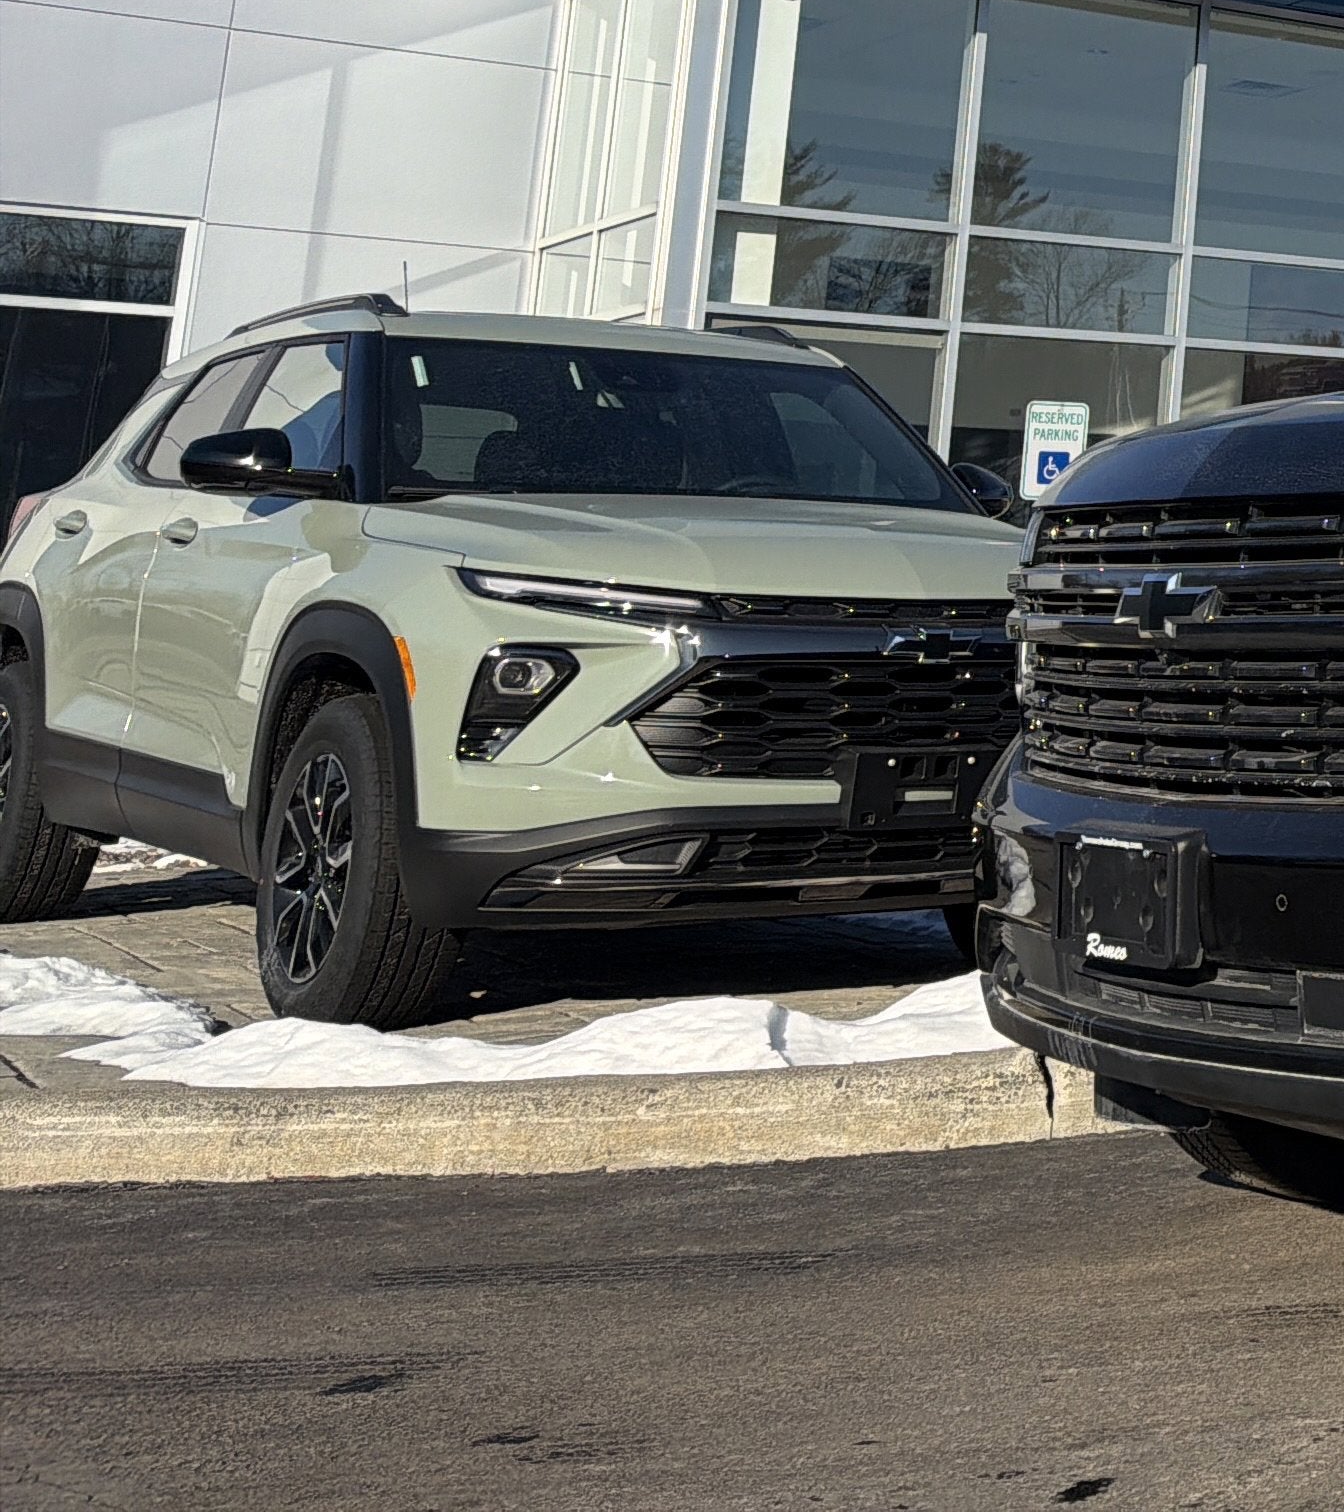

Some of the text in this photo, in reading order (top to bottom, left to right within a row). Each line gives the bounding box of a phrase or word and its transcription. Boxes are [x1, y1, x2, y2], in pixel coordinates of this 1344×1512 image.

[1031, 412, 1083, 425] RESERVED
[1033, 428, 1079, 441] PARKING
[1086, 933, 1128, 961] Romeo
